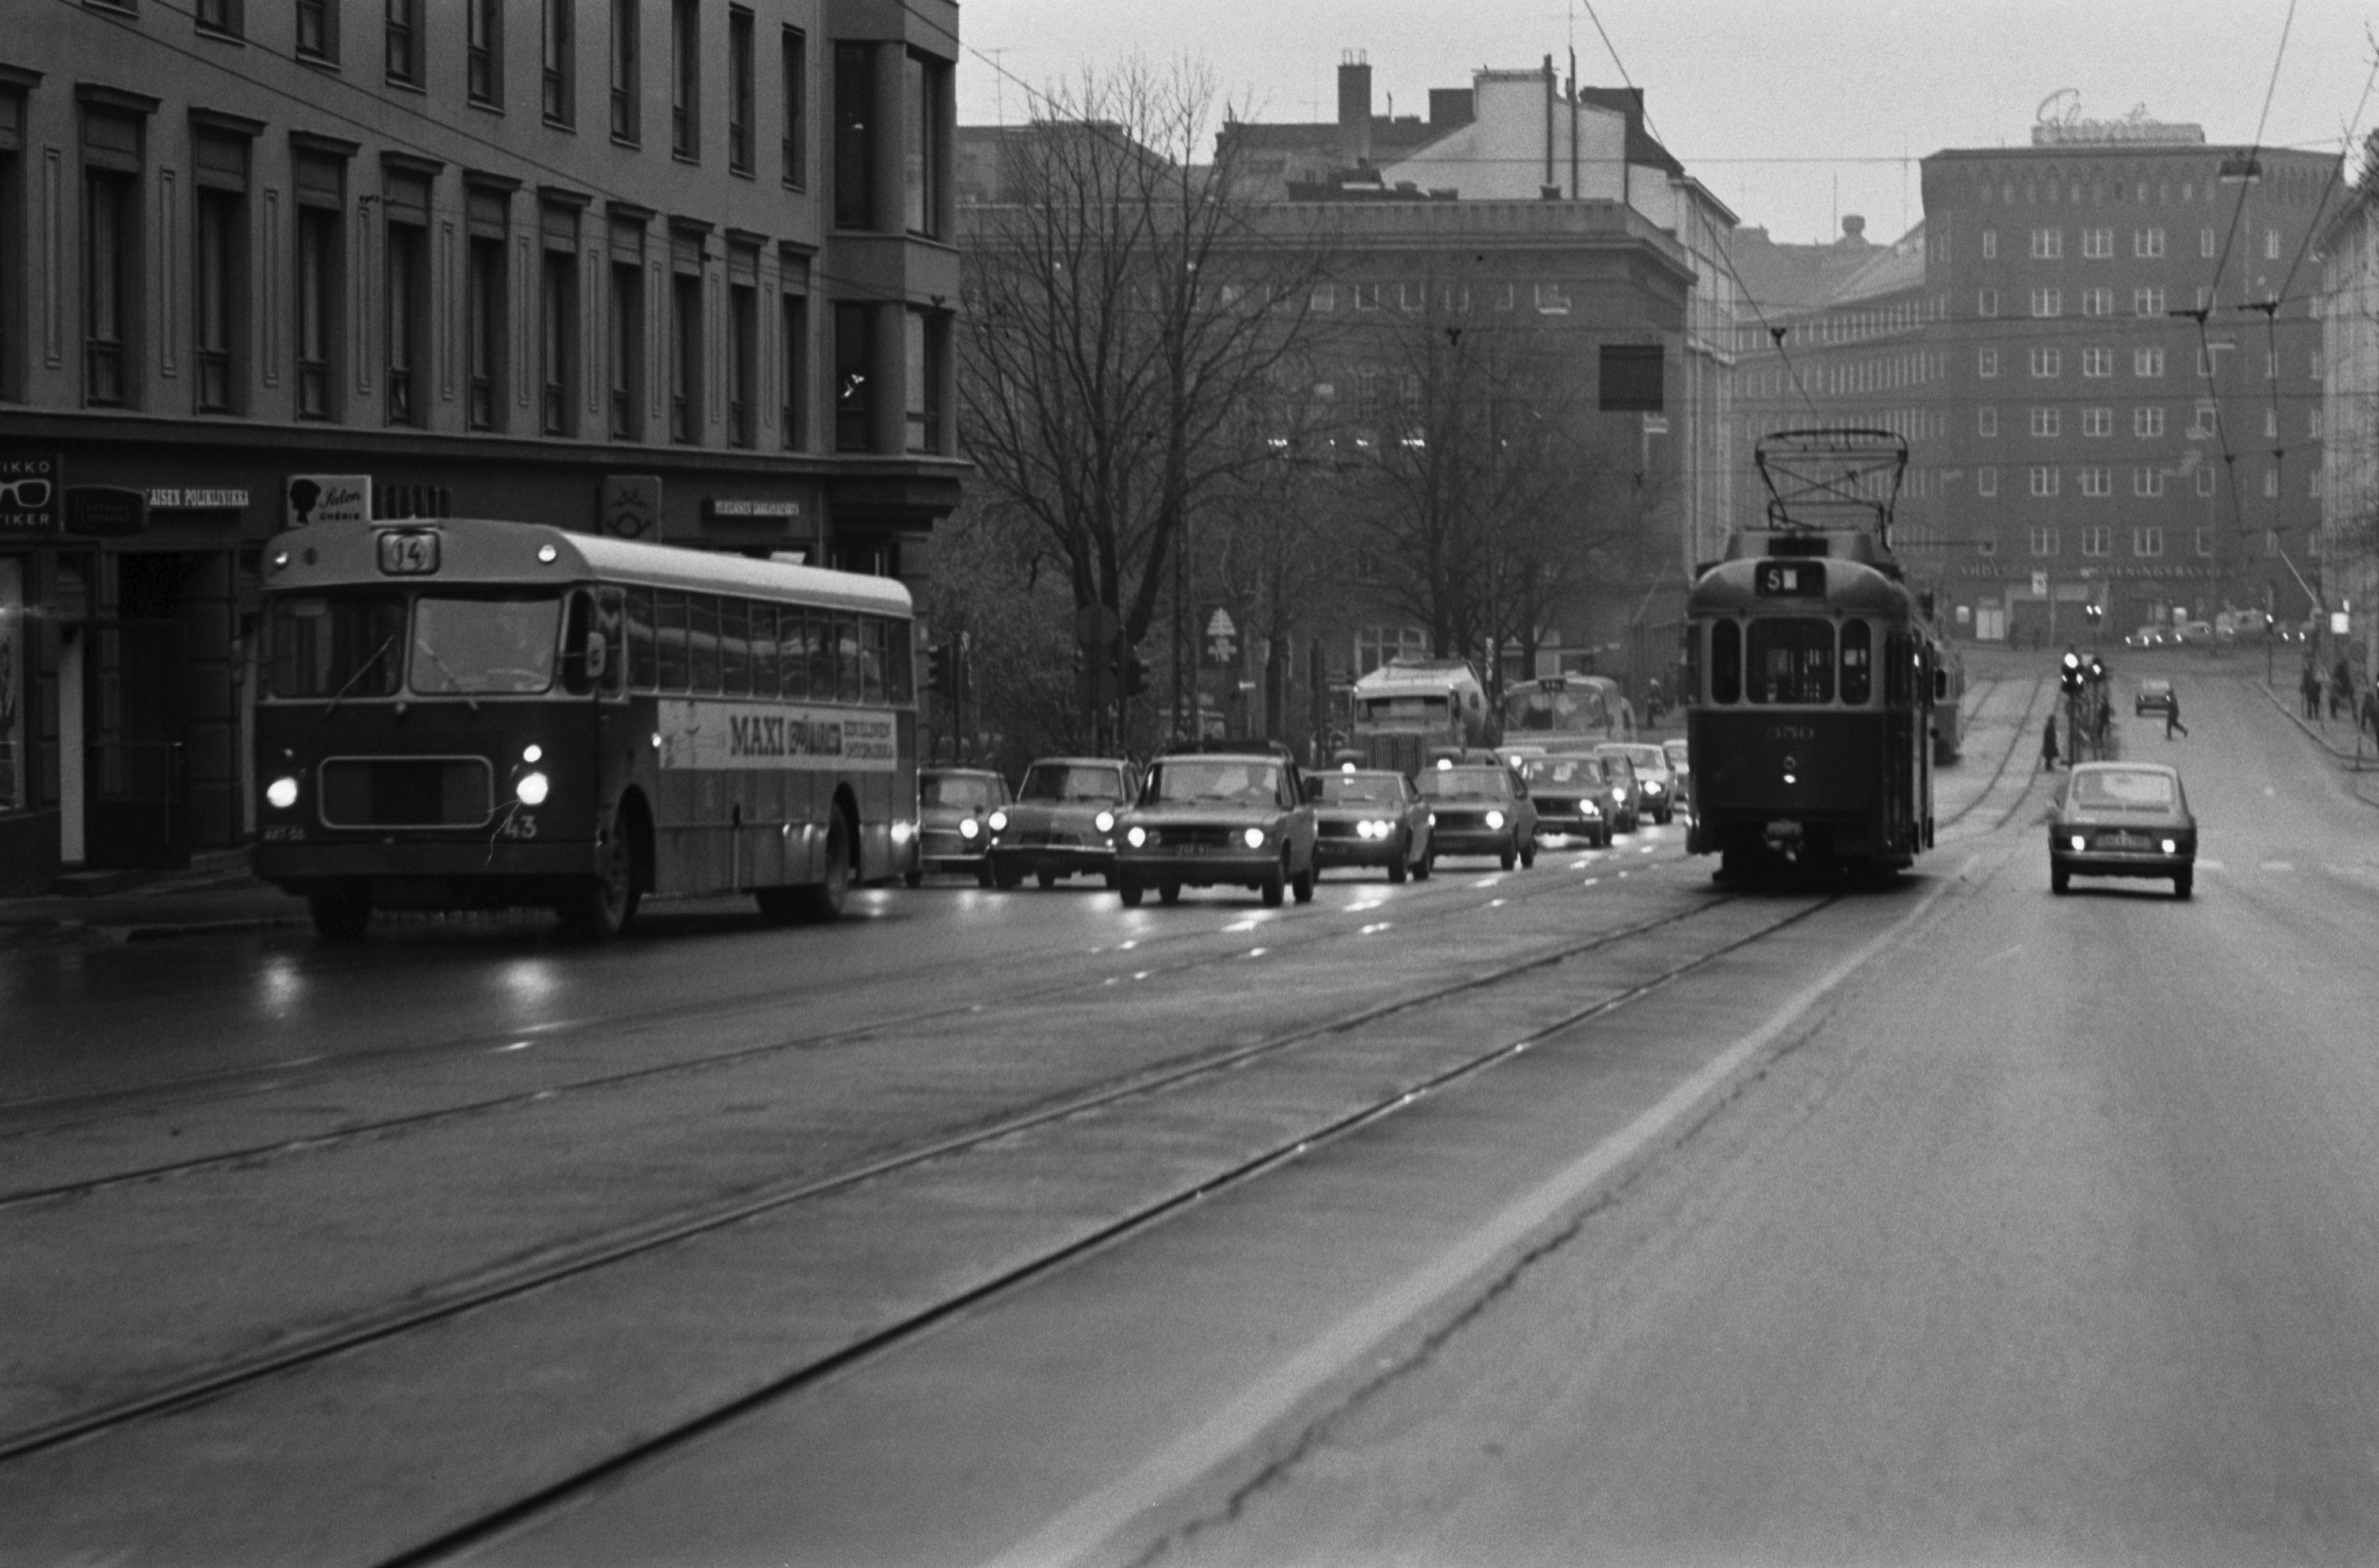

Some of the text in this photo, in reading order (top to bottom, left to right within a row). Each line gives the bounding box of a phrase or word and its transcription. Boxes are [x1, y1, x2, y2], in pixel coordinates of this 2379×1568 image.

[0, 460, 50, 473] IKKO
[184, 489, 249, 506] POLIKLINIKKA
[319, 486, 361, 508] Salon
[0, 513, 50, 526] IKER
[396, 541, 421, 566] 14
[730, 715, 784, 756] MAXI
[504, 814, 538, 839] 43
